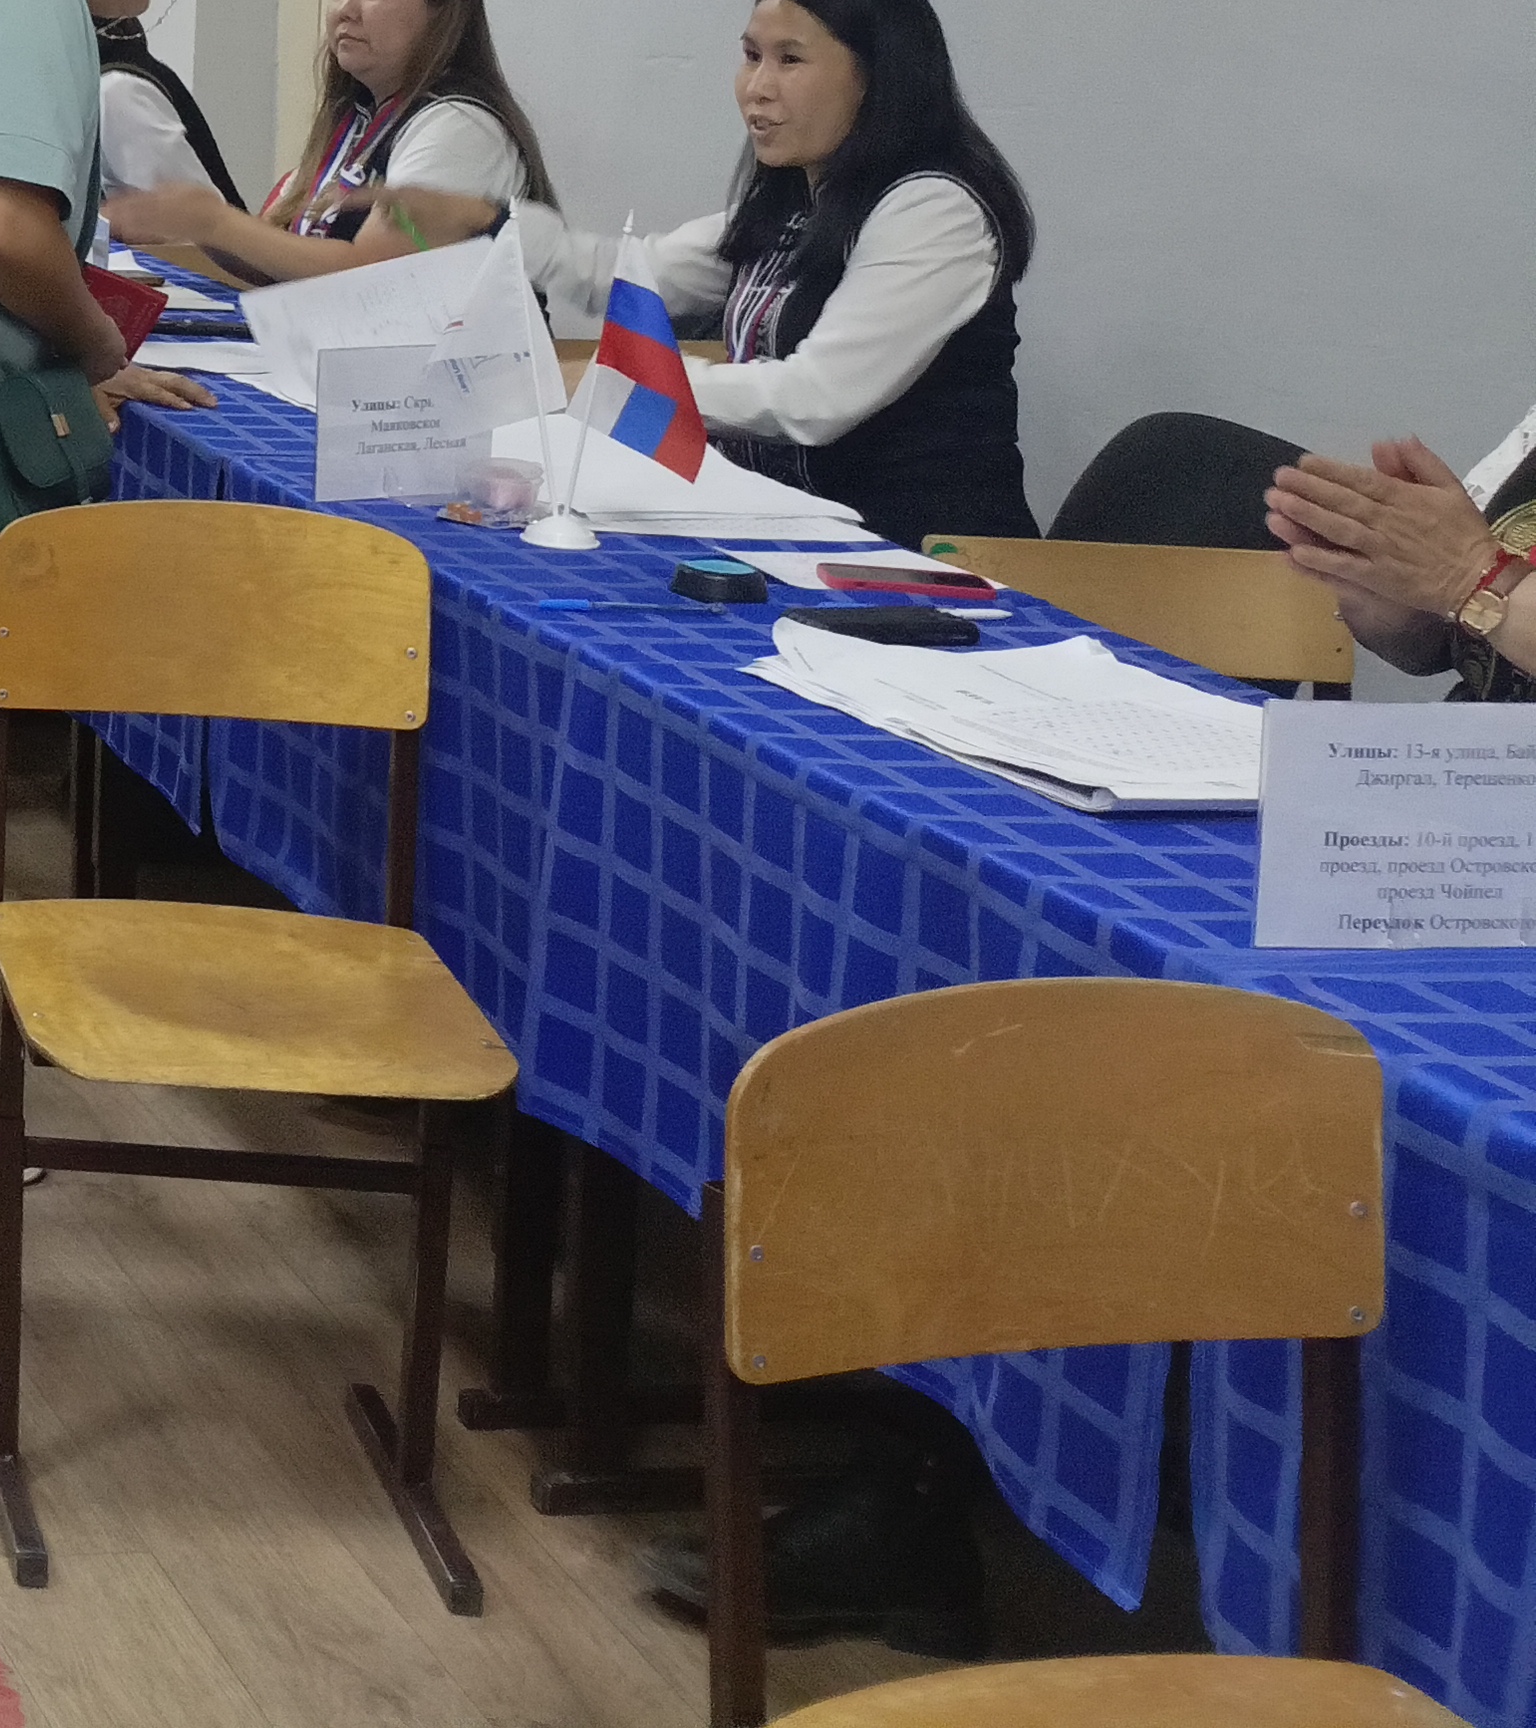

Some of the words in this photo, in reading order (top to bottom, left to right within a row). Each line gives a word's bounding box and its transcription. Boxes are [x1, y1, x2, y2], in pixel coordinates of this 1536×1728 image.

[351, 399, 400, 412] Улицы:
[1328, 743, 1398, 759] Улицы:
[1406, 743, 1440, 759] 13-я
[1355, 769, 1438, 789] Джиргал,
[1324, 831, 1409, 851] Проезды:
[1319, 861, 1381, 877] проезд,
[1387, 861, 1445, 877] проезд
[1377, 887, 1435, 903] проезд
[1339, 913, 1425, 933] Переулок
